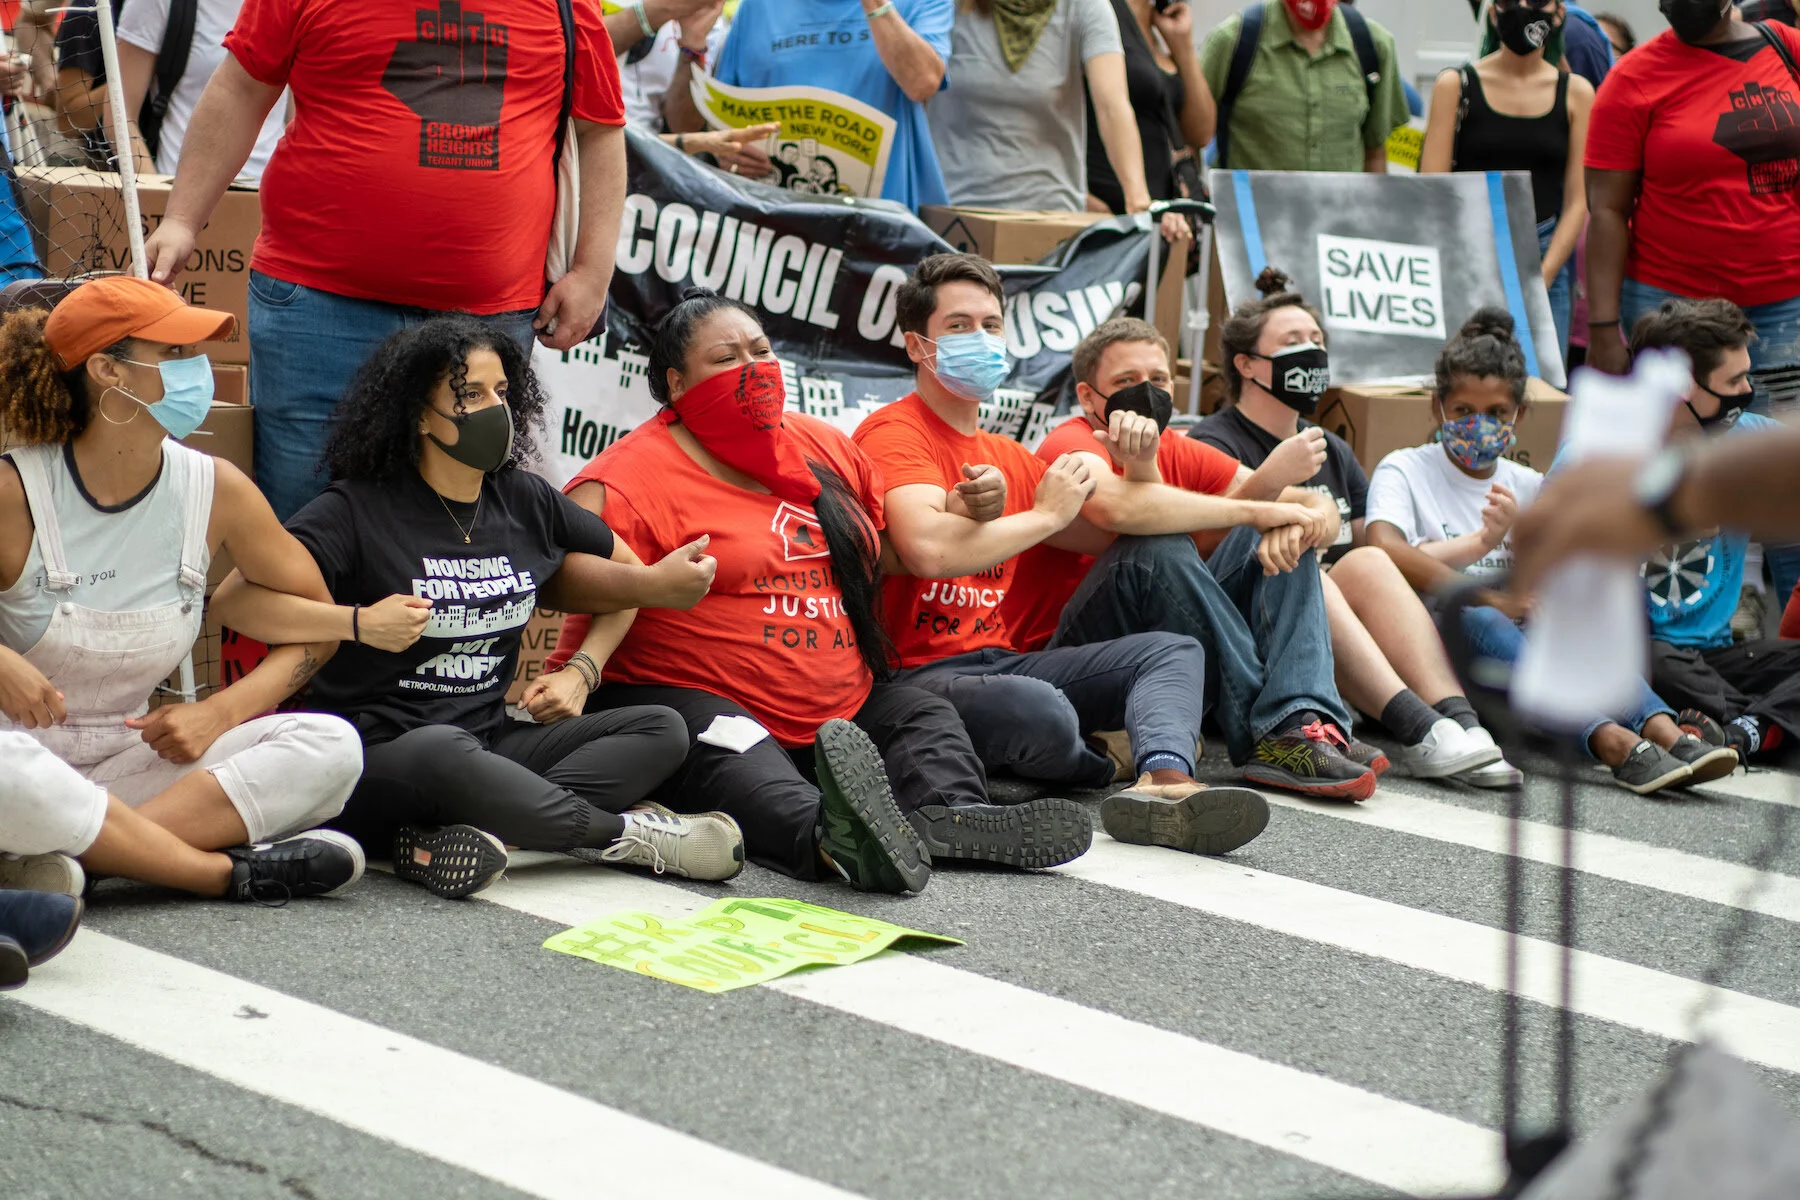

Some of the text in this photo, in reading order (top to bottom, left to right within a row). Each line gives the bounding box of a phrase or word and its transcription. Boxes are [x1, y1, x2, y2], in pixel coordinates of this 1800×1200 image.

[421, 20, 505, 46] CHTU
[771, 33, 820, 52] HERE
[827, 31, 852, 44] TO
[426, 122, 495, 141] CROWN
[721, 100, 877, 143] MAKE THE ROAD
[426, 139, 494, 156] HEIGHTS
[789, 123, 873, 158] NEW YORK
[427, 156, 493, 168] TENANT UNION
[93, 249, 245, 272] EVONS
[1327, 248, 1431, 287] SAVE
[614, 193, 1141, 359] COUNCIL O USIN
[1326, 287, 1436, 328] LIVES
[561, 407, 633, 460] HOU
[90, 569, 116, 586] you
[422, 556, 514, 579] HOUSING
[753, 566, 836, 592] HOUSI
[412, 571, 537, 600] FOR PEOPLE
[763, 594, 849, 619] JUSTIC
[915, 611, 960, 635] FOR
[763, 625, 855, 649] FOR AL
[398, 679, 453, 694] METROPOLITAN
